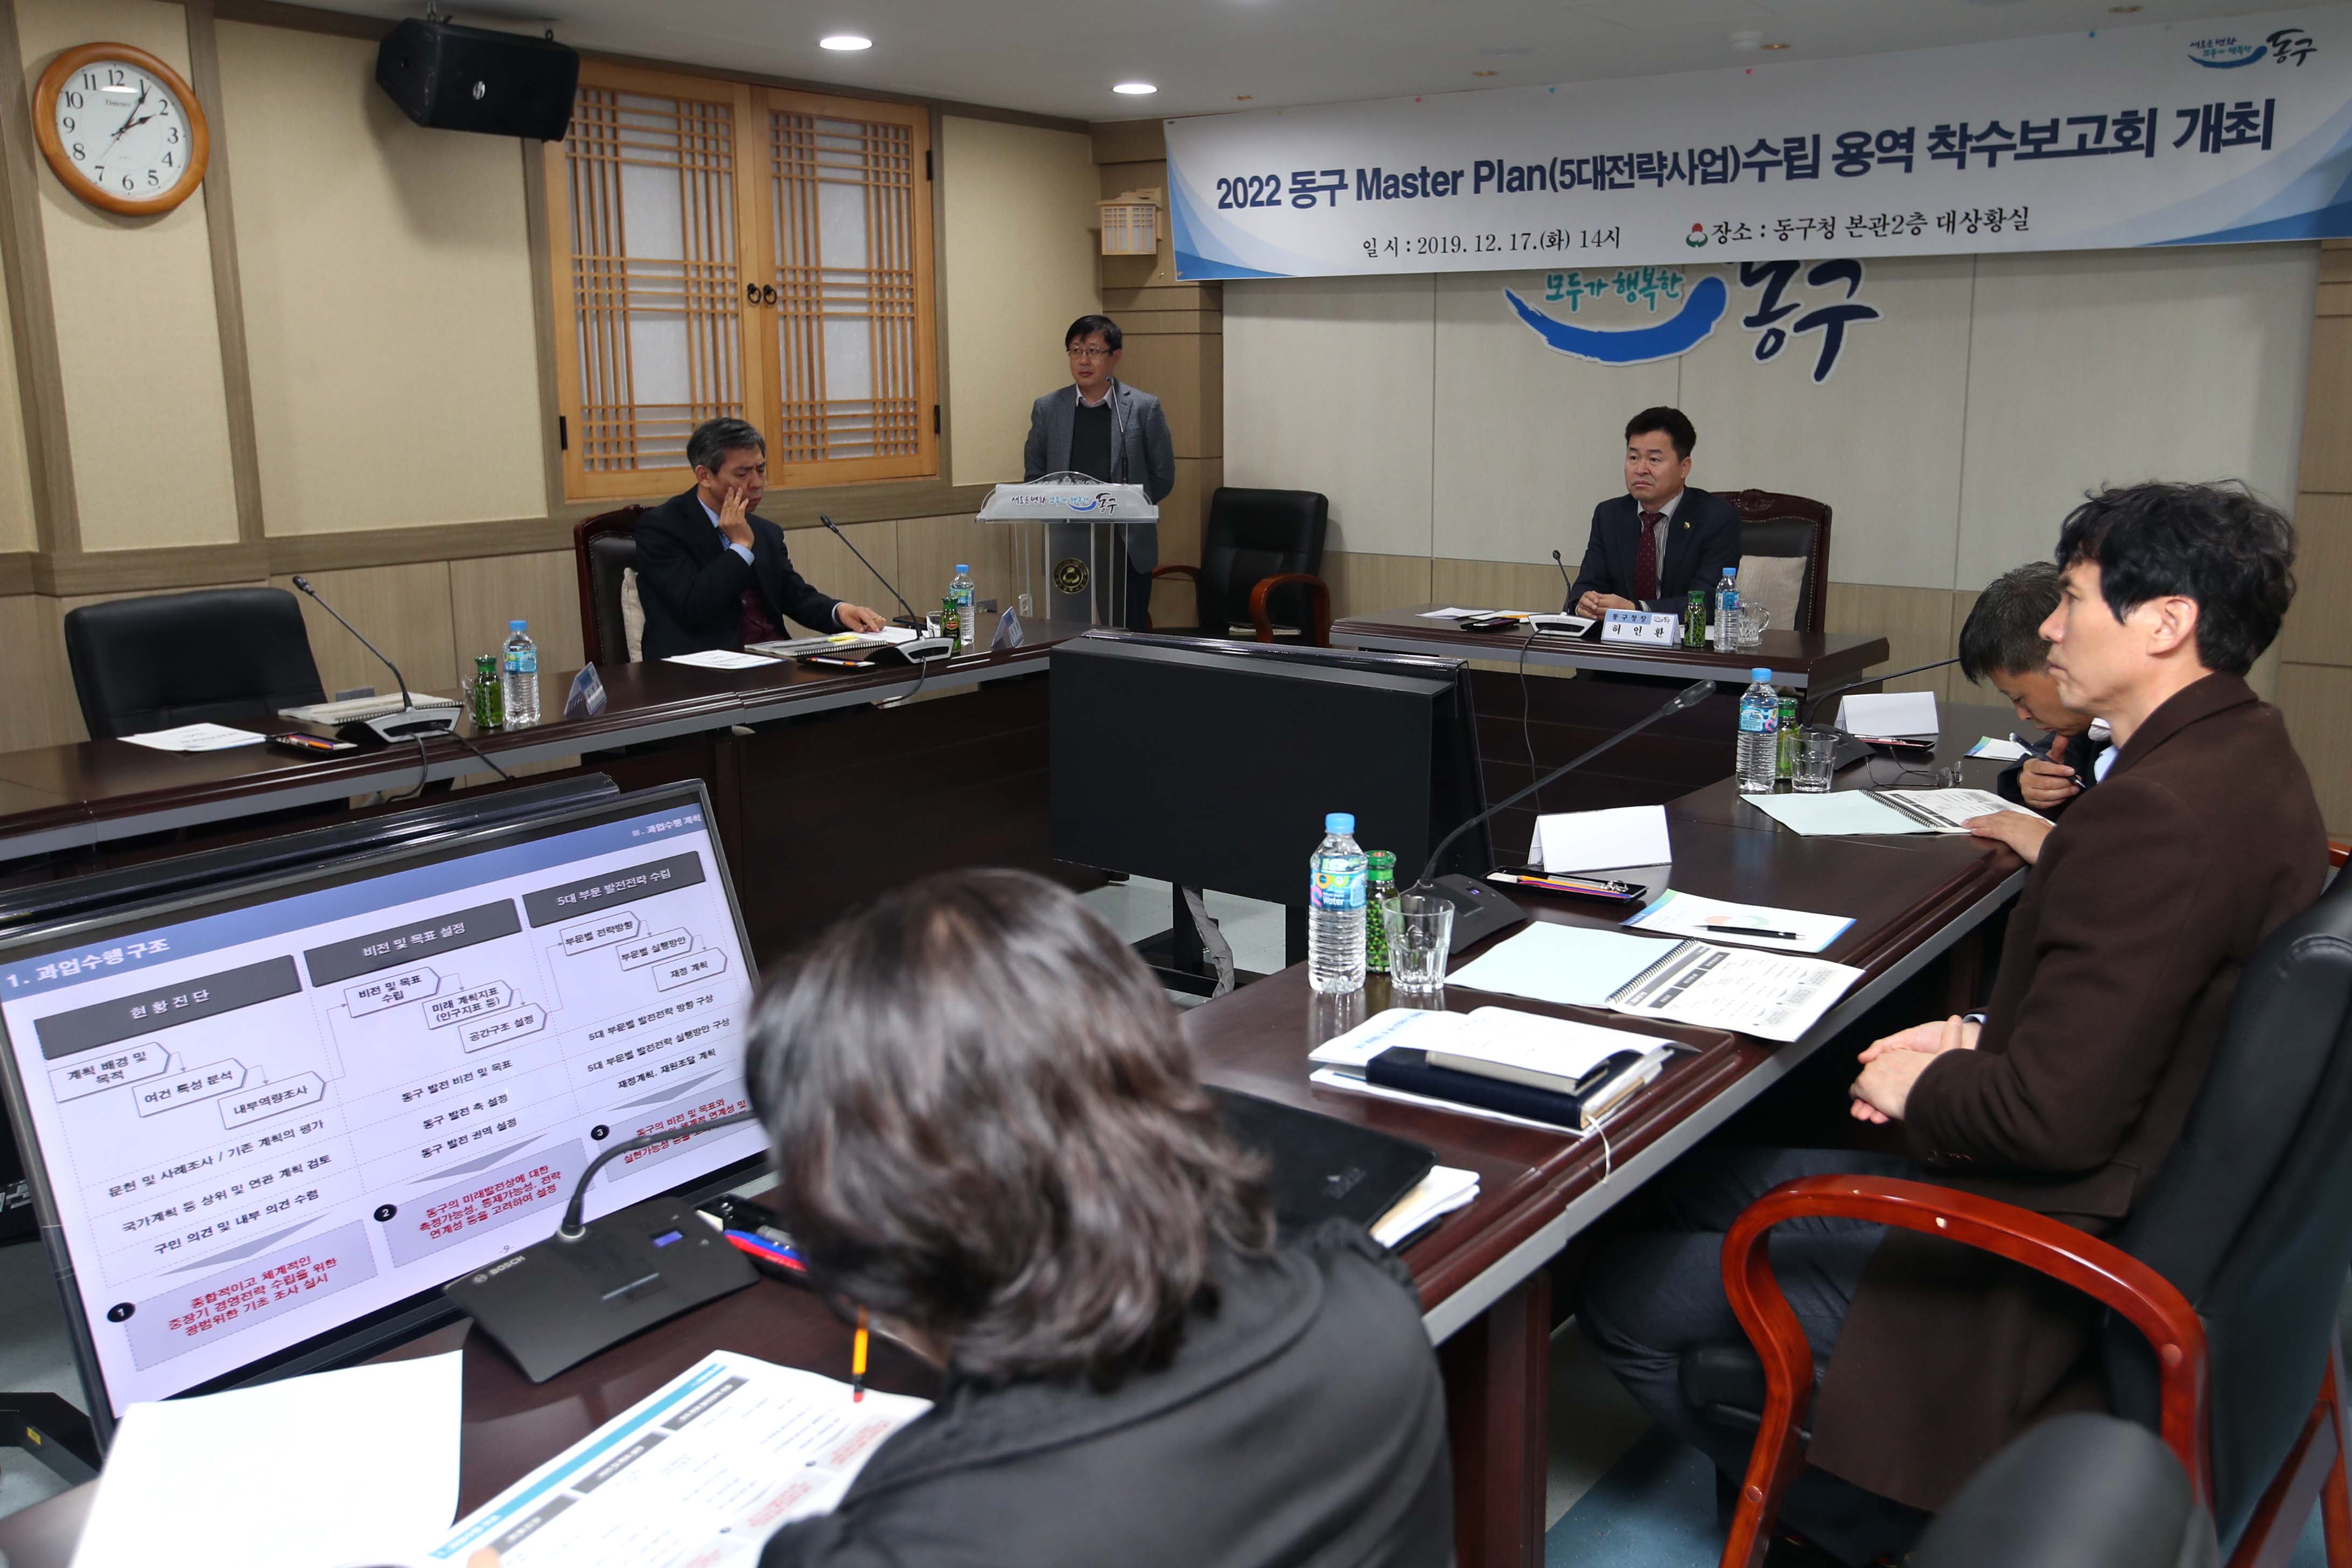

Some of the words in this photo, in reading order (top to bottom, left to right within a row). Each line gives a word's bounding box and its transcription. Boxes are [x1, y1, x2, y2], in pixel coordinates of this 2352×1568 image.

[2266, 29, 2318, 67] 동구
[83, 74, 96, 90] 11
[109, 70, 125, 86] 12
[65, 91, 83, 109] 10
[159, 100, 169, 115] 2
[63, 117, 75, 133] 9
[167, 128, 178, 143] 3
[73, 144, 86, 160] 8
[162, 152, 173, 167] 4
[1217, 174, 1281, 209] 2022
[1289, 169, 1348, 208] 동구
[1356, 166, 1464, 200] Master
[1832, 127, 1915, 177] 용역
[1927, 108, 2158, 170] 착수보고회
[2173, 99, 2275, 153] 개최
[95, 166, 104, 181] 7
[123, 174, 134, 190] 6
[148, 170, 159, 185] 5
[1773, 216, 1836, 242] 동구청
[1845, 212, 1928, 238] 본관2층
[1937, 206, 2029, 235] 대상황실
[1417, 235, 1467, 254] 2019.
[1475, 234, 1502, 252] 12.
[1580, 226, 1620, 249] 14시
[1545, 272, 1607, 311] 모두가
[1614, 267, 1682, 311] 행복한
[1012, 495, 1029, 505] 새로운
[1031, 495, 1046, 505] 변화
[1096, 493, 1118, 514] 동구
[557, 893, 577, 907] 5대
[579, 887, 602, 901] 부문
[604, 874, 648, 895] 발전전략
[649, 868, 671, 883] 수립
[362, 944, 391, 958] 비전
[394, 937, 408, 950] 및
[411, 930, 438, 944] 목표
[440, 922, 466, 938] 설정
[565, 932, 594, 946] 부문별
[596, 920, 634, 938] 전략방향
[621, 947, 649, 962] 부문별
[651, 936, 687, 954] 실행방안
[670, 968, 688, 978] 재정
[691, 961, 709, 972] 계획
[358, 986, 381, 999] 비전
[385, 981, 397, 992] 및
[400, 974, 423, 987] 목표
[381, 990, 405, 1004] 수립
[432, 999, 454, 1013] 미래
[458, 987, 500, 1005] 계획지표
[436, 1001, 482, 1023] (인구지표
[486, 996, 500, 1009] 등)
[469, 1022, 512, 1042] 공간구조
[515, 1014, 534, 1028] 설정
[589, 1030, 605, 1041] 5대
[607, 1019, 635, 1035] 부문별
[638, 1007, 674, 1025] 발전전략
[676, 1000, 694, 1012] 방향
[696, 994, 714, 1005] 구상
[587, 1061, 604, 1073] 5대
[606, 1050, 634, 1066] 부문별
[636, 1037, 673, 1055] 발전전략
[675, 1024, 710, 1043] 실행방안
[712, 1018, 731, 1029] 구상
[67, 1065, 96, 1081] 계획
[101, 1055, 129, 1072] 배경
[133, 1051, 148, 1063] 및
[661, 1055, 696, 1073] 재원조달
[699, 1048, 716, 1061] 계획
[96, 1069, 125, 1085] 목적
[402, 1088, 424, 1103] 동구
[428, 1080, 450, 1094] 발전
[452, 1072, 474, 1084] 비전
[477, 1067, 489, 1078] 및
[491, 1060, 513, 1072] 목표
[144, 1088, 172, 1104] 여건
[177, 1079, 204, 1094] 특성
[233, 1084, 309, 1116] 내부역량조사
[423, 1115, 445, 1130] 동구
[448, 1107, 470, 1121] 발전
[487, 1094, 508, 1108] 설정
[636, 1121, 664, 1138] 동구의
[667, 1113, 685, 1125] 비전
[688, 1109, 697, 1118] 및
[699, 1098, 725, 1113] 목표와
[709, 1104, 735, 1120] 연계성
[737, 1100, 747, 1109] 및
[421, 1144, 443, 1158] 동구
[447, 1135, 469, 1150] 발전
[472, 1126, 494, 1140] 권역
[496, 1118, 517, 1132] 설정
[108, 1180, 137, 1198] 문헌
[142, 1174, 157, 1187] 및
[161, 1156, 214, 1181] 사례조사
[228, 1142, 254, 1158] 기존
[258, 1129, 296, 1147] 계획의
[299, 1119, 324, 1135] 평가
[624, 1140, 669, 1164] 실현가능성
[541, 1171, 562, 1185] 전략
[122, 1206, 179, 1232] 국가계획
[183, 1200, 197, 1213] 등
[201, 1189, 228, 1207] 상위
[231, 1184, 245, 1196] 및
[248, 1173, 275, 1190] 연관
[278, 1163, 304, 1179] 계획
[307, 1154, 332, 1171] 검토
[426, 1199, 459, 1219] 동구의
[463, 1174, 526, 1204] 미래발전상에
[529, 1165, 549, 1178] 대한
[153, 1238, 182, 1255] 구민
[186, 1226, 214, 1243] 의견
[217, 1220, 232, 1233] 및
[236, 1210, 262, 1227] 내부
[265, 1199, 291, 1215] 의견
[293, 1188, 319, 1205] 수렴
[430, 1221, 464, 1240] 연계성
[466, 1210, 488, 1226] 등을
[492, 1193, 533, 1216] 고려하여
[536, 1184, 557, 1199] 설정
[489, 1256, 526, 1275] BOSCH
[168, 1307, 210, 1331] 중장기
[215, 1284, 267, 1313] 경영전략
[271, 1270, 309, 1290] 수립을
[313, 1257, 338, 1272] 위한
[191, 1277, 257, 1309] 종합적이고
[262, 1255, 312, 1281] 체계적인
[185, 1308, 239, 1336] 광범위한
[244, 1297, 270, 1313] 기초
[274, 1285, 299, 1301] 조사
[303, 1272, 329, 1290] 실시
